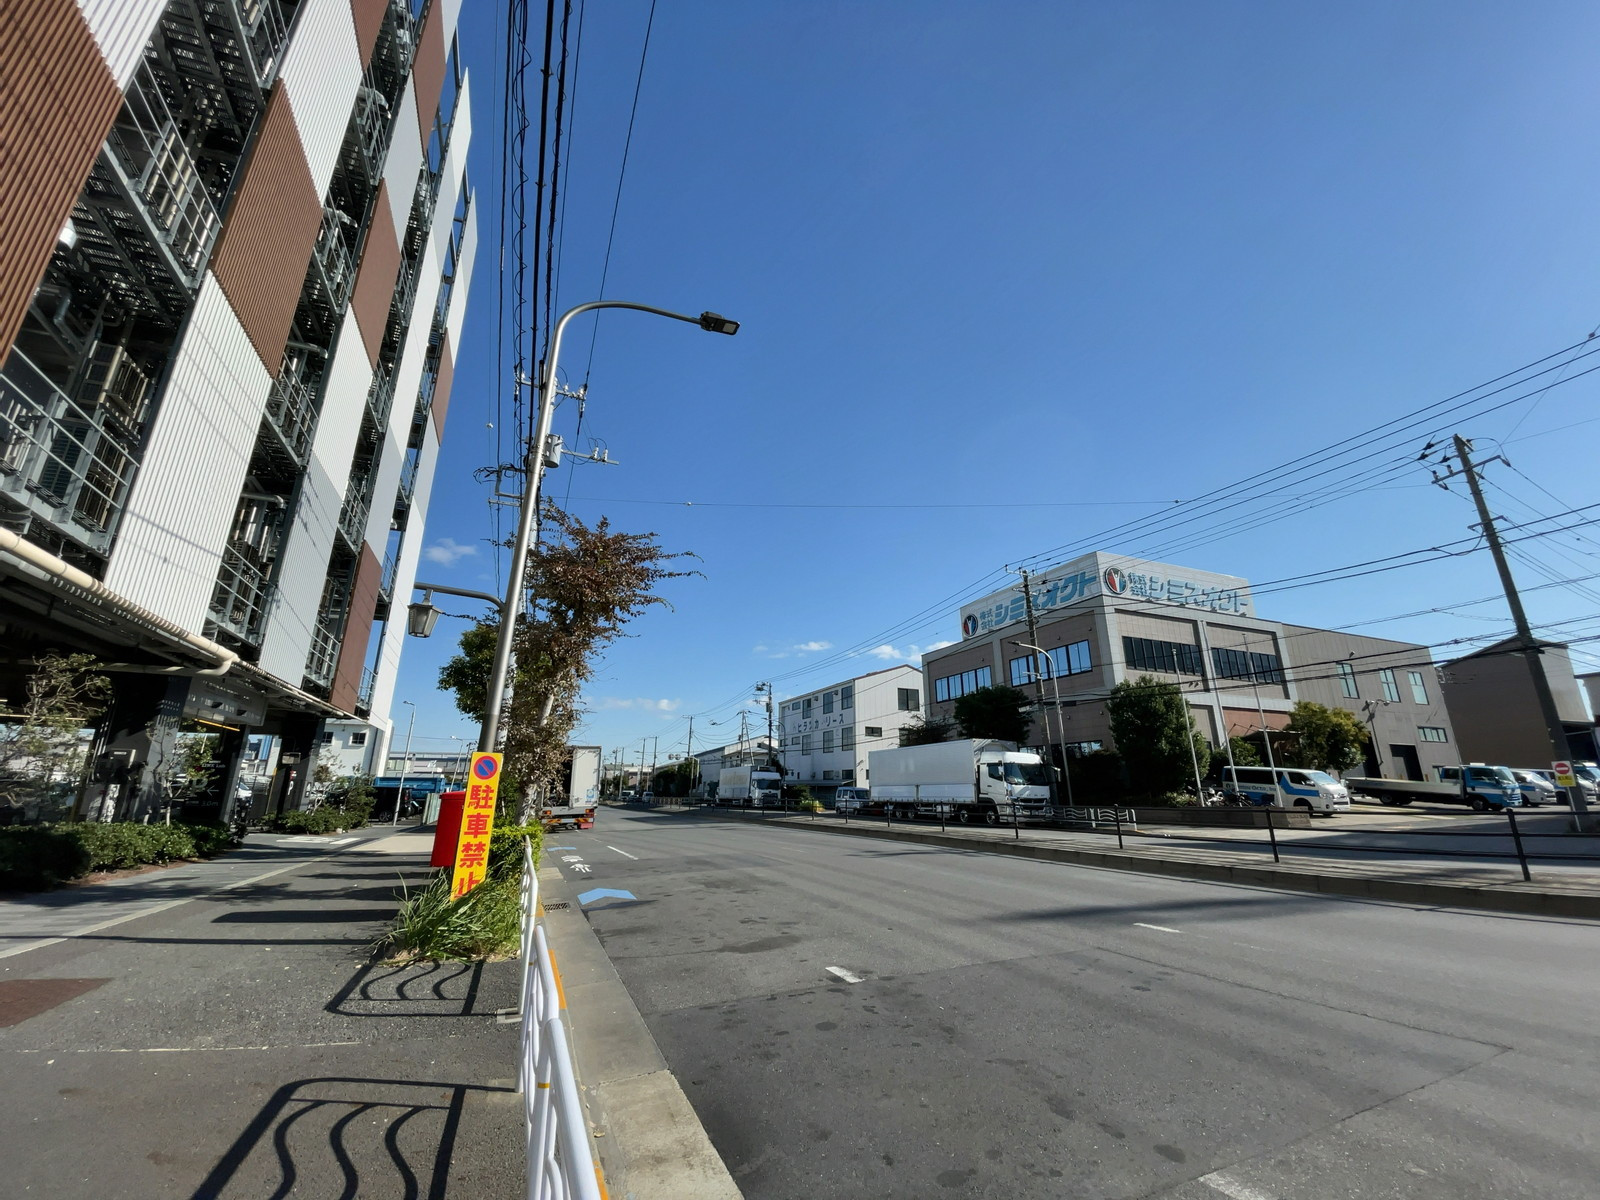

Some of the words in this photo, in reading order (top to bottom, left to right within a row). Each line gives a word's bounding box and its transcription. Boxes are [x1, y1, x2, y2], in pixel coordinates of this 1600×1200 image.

[995, 571, 1097, 625] シミズオクト
[1149, 575, 1249, 613] シミズオクト
[453, 784, 495, 899] 駐車禁止
